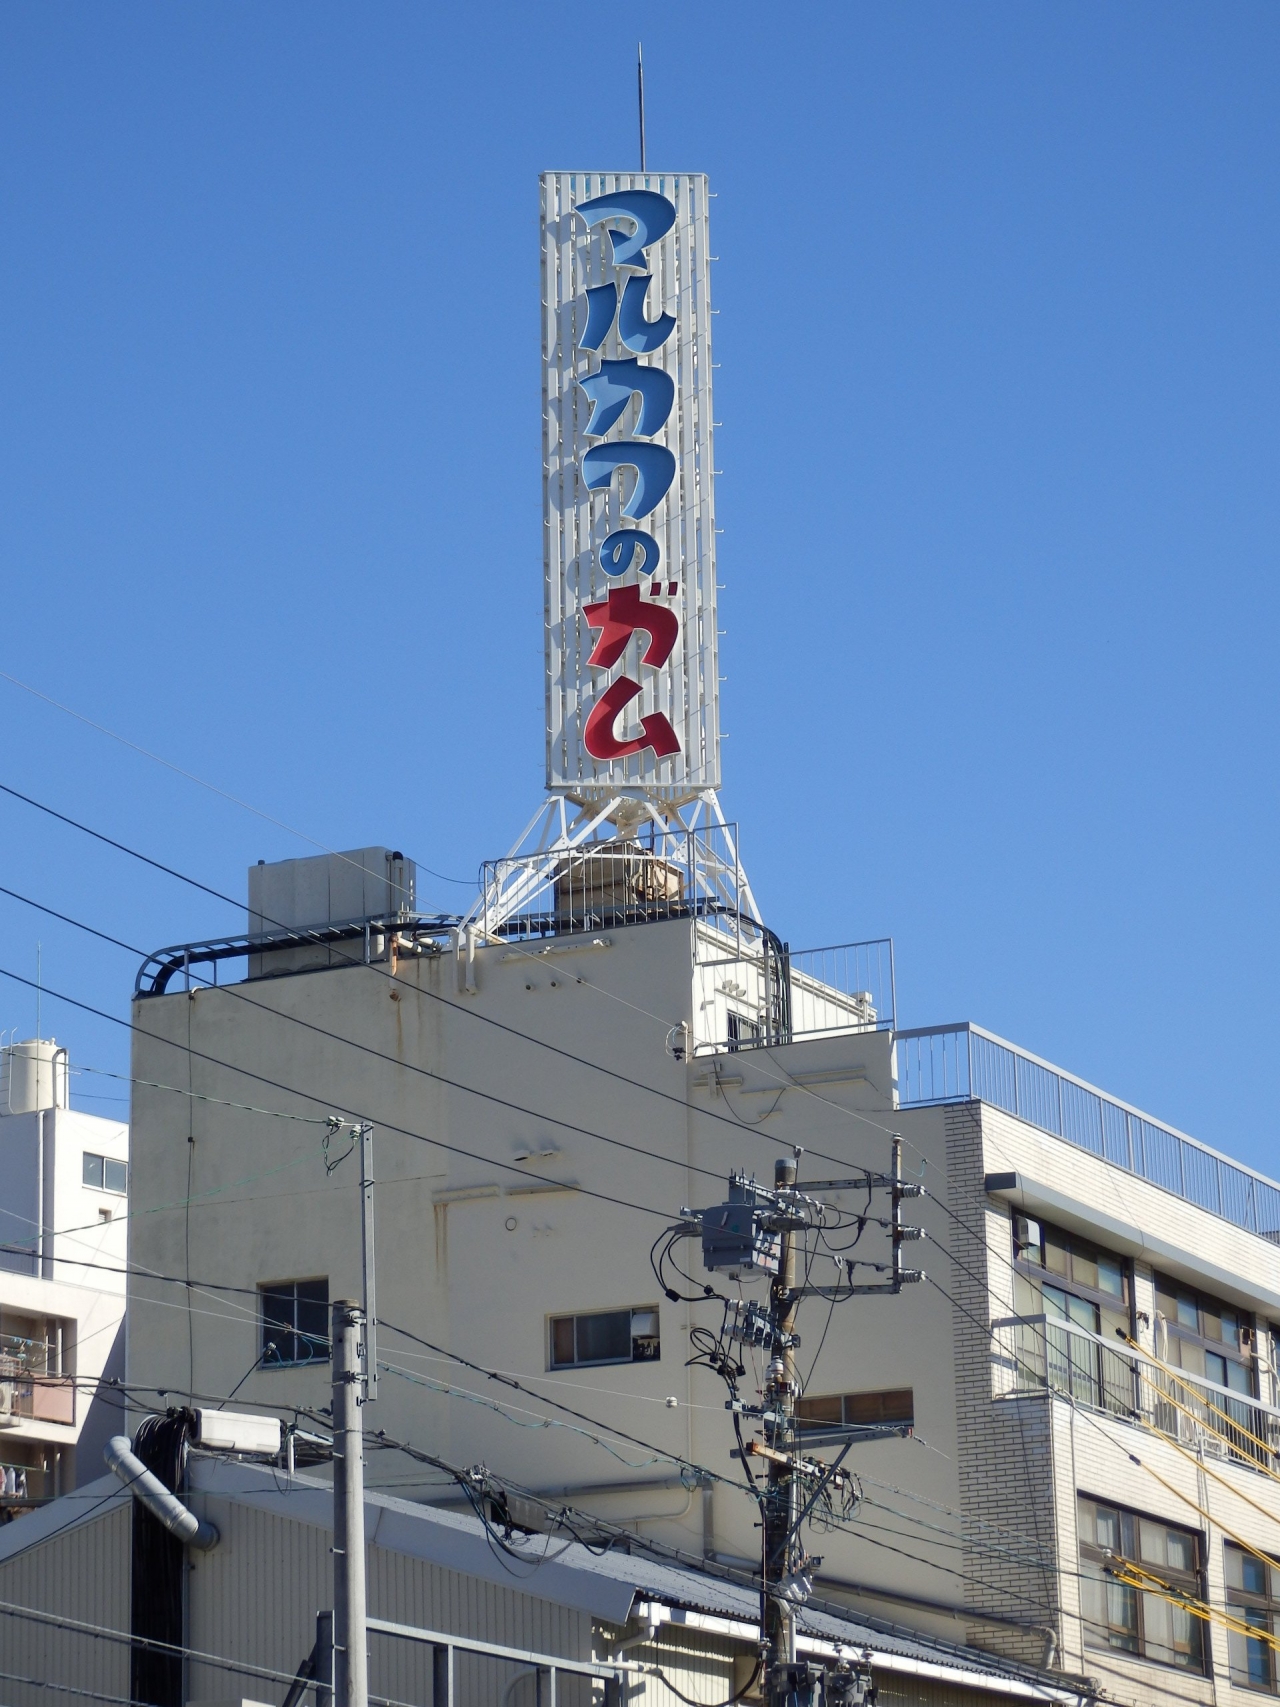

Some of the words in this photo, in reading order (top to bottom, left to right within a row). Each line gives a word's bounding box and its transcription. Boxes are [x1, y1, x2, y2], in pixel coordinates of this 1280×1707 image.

[573, 189, 682, 761] マルカワのガム
